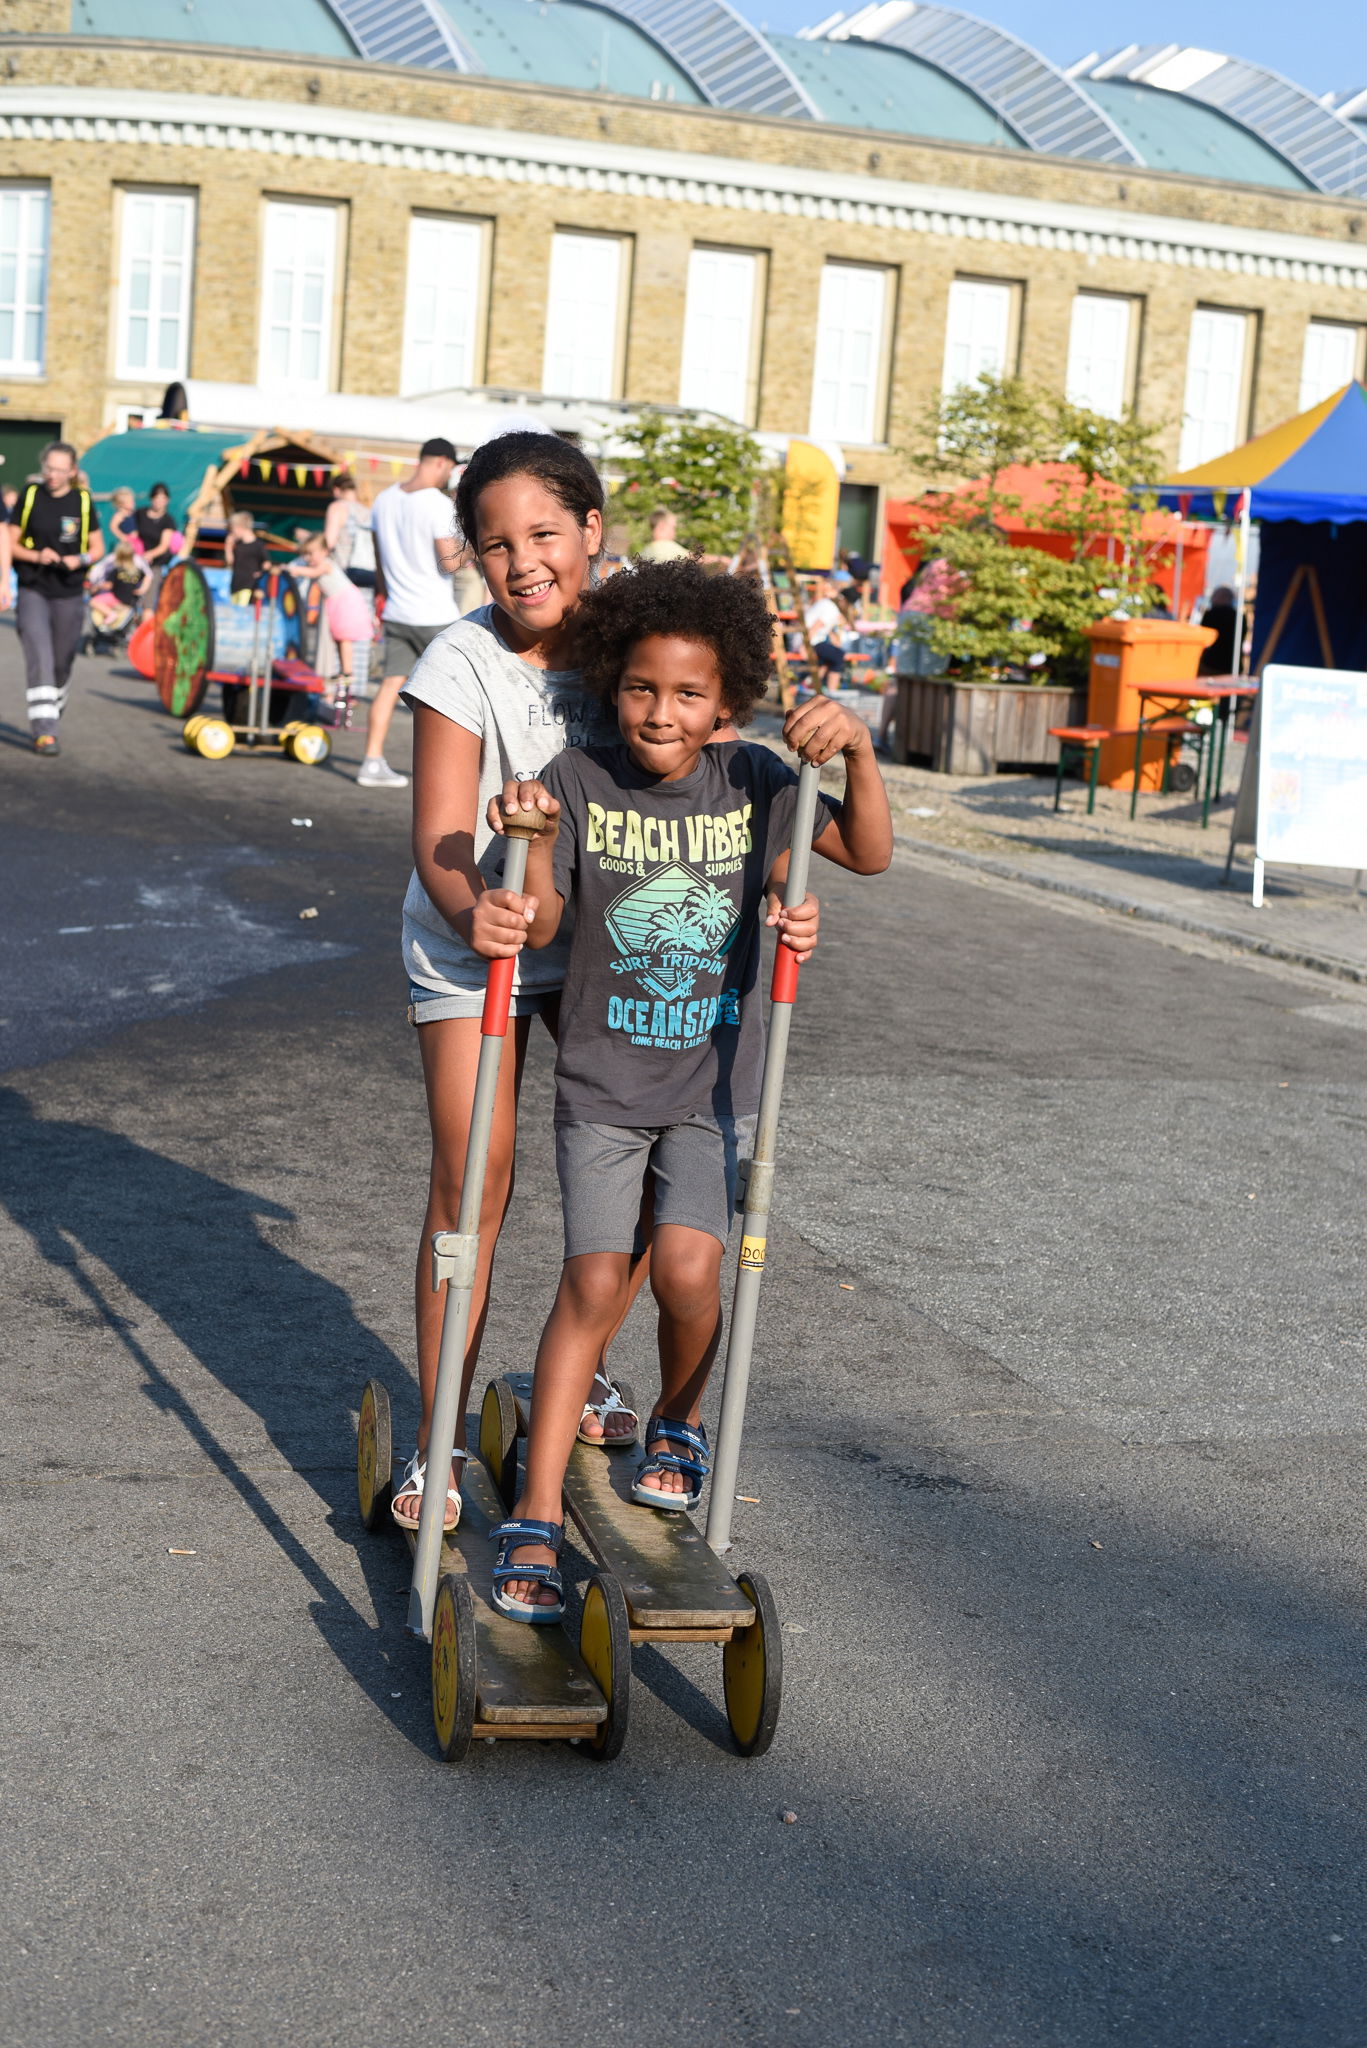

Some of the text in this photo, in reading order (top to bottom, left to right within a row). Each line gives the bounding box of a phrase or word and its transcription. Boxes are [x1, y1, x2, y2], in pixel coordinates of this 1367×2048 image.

[586, 802, 680, 863] BEACH
[599, 857, 634, 875] GOODS
[636, 861, 646, 876] &
[609, 954, 726, 976] SURF TRIPPIN
[631, 1034, 652, 1047] LONG
[654, 1037, 681, 1051] BEACH
[682, 1430, 701, 1442] GEOX
